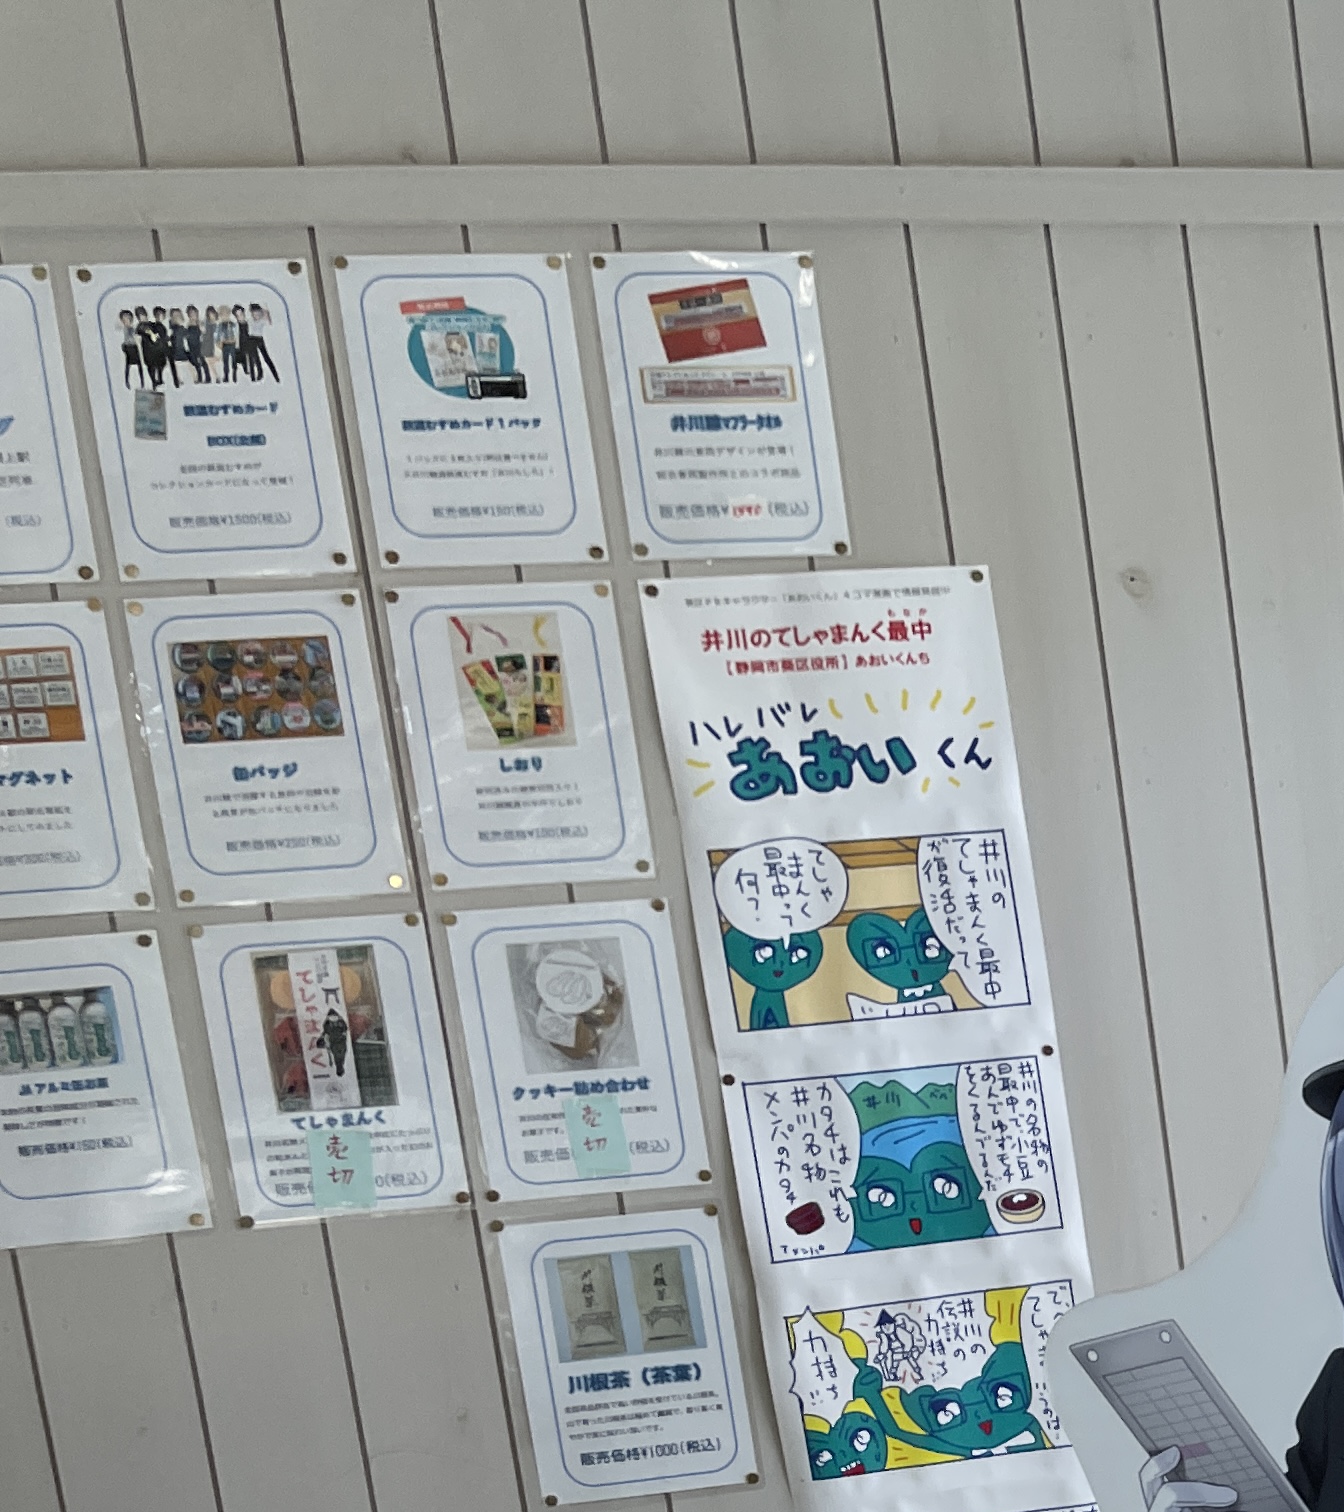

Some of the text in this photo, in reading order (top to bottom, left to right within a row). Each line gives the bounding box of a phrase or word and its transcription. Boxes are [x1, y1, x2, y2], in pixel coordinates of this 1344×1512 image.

[701, 619, 933, 653] 井川のてしゃまんく最中
[688, 702, 819, 746] ハレバレ
[726, 729, 918, 802] あおい
[937, 736, 993, 771] くん
[808, 849, 833, 904] てしゃ
[978, 839, 1006, 910] 井川の
[512, 1076, 651, 1101] クッキー詰め合わせ
[290, 1109, 387, 1131] てしゃまんく
[957, 1298, 987, 1355] 井川の
